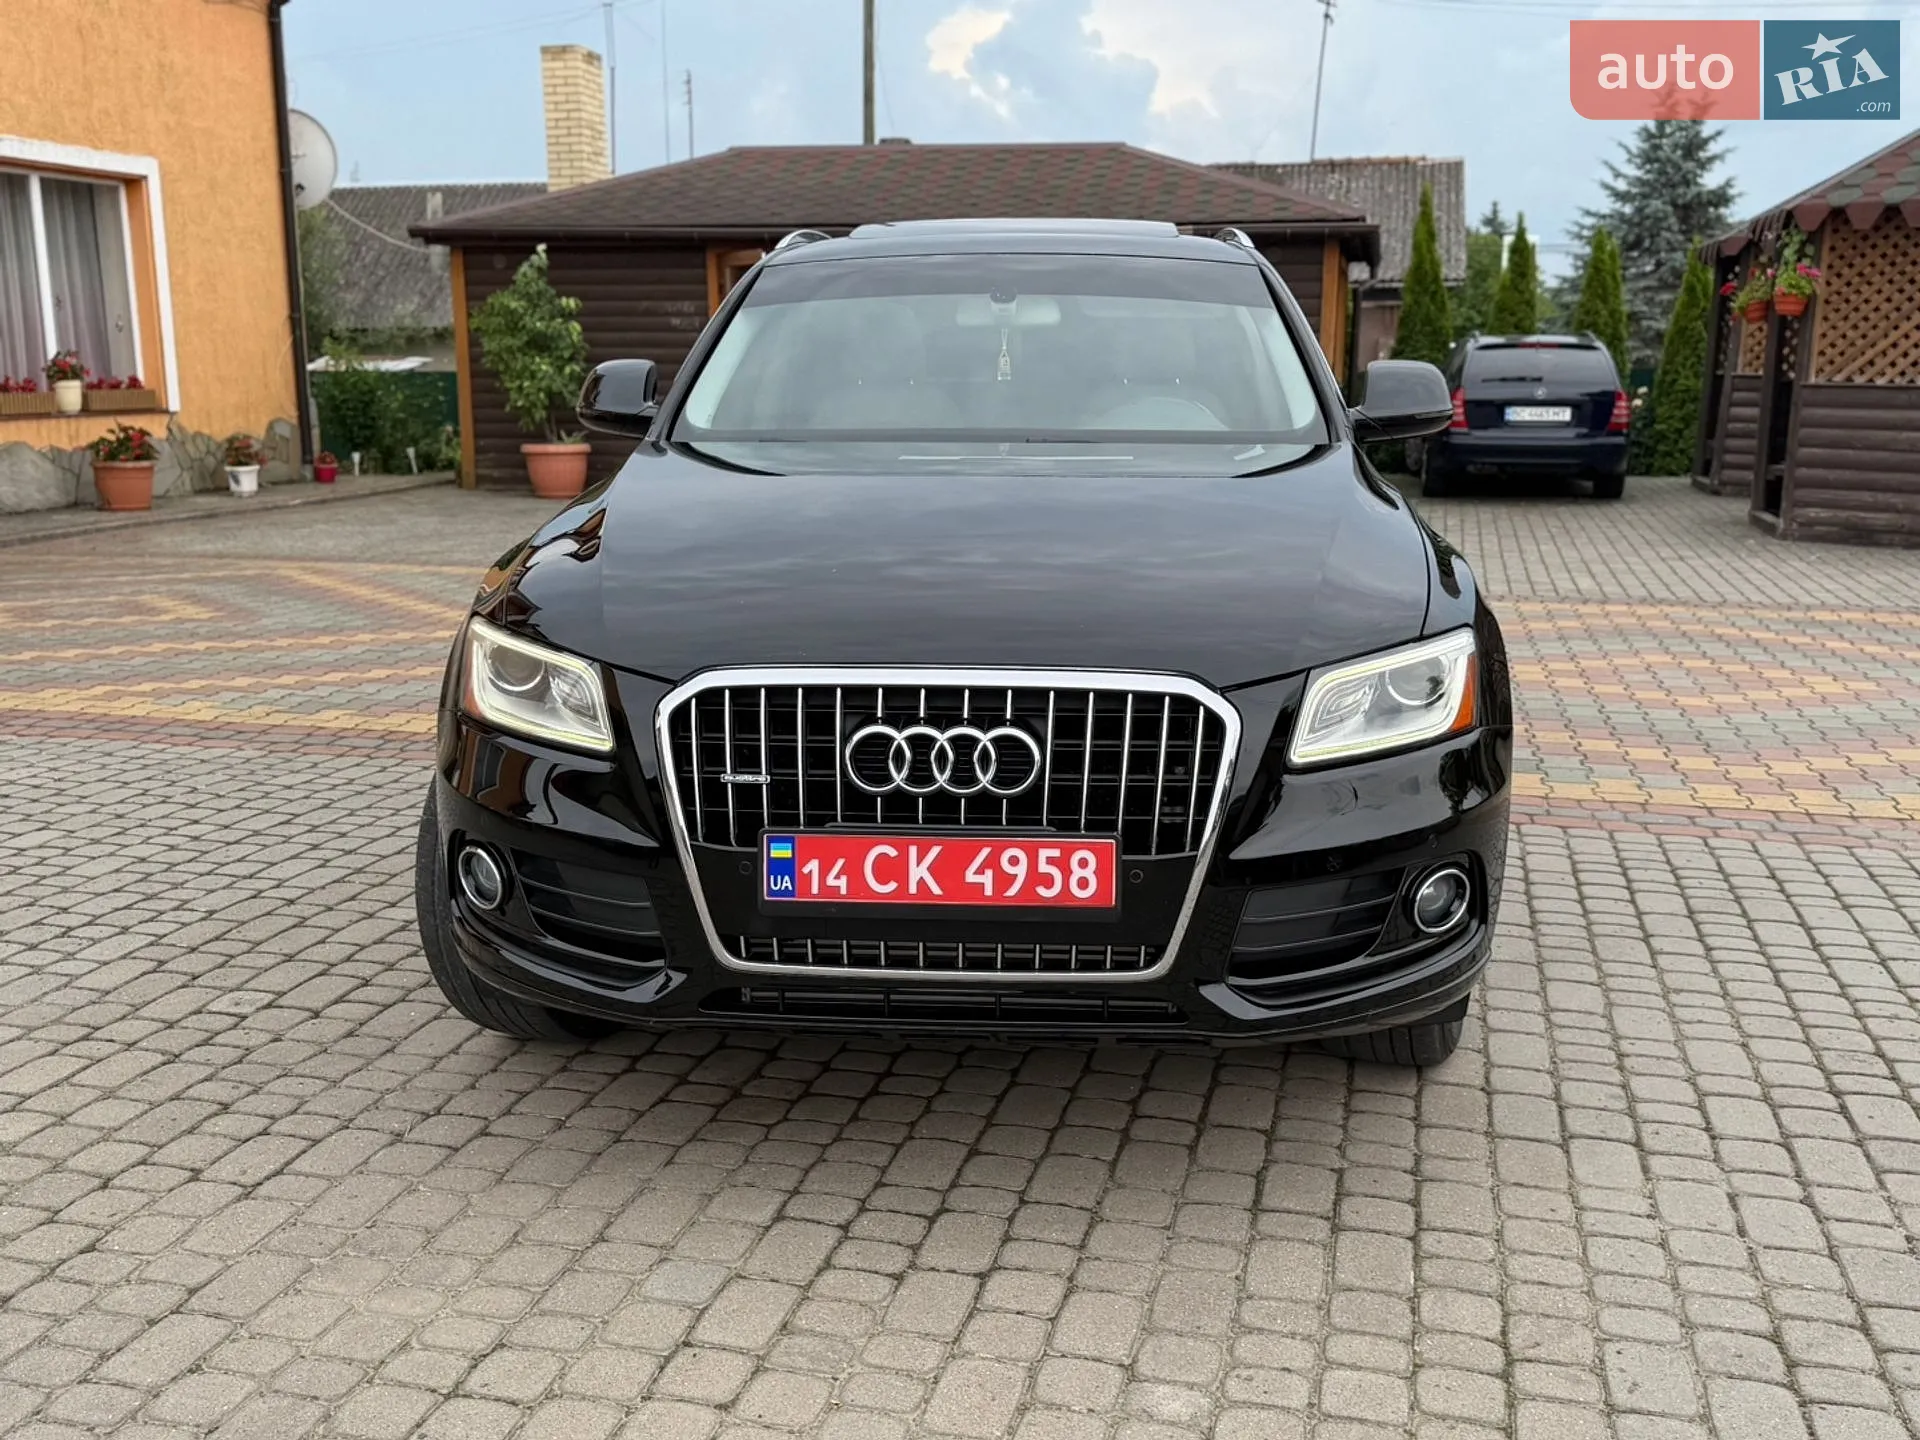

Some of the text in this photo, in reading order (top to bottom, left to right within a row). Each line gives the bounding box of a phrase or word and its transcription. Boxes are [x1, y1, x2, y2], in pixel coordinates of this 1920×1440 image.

[770, 875, 792, 891] UA
[801, 844, 1098, 899] 14 CK 4958
